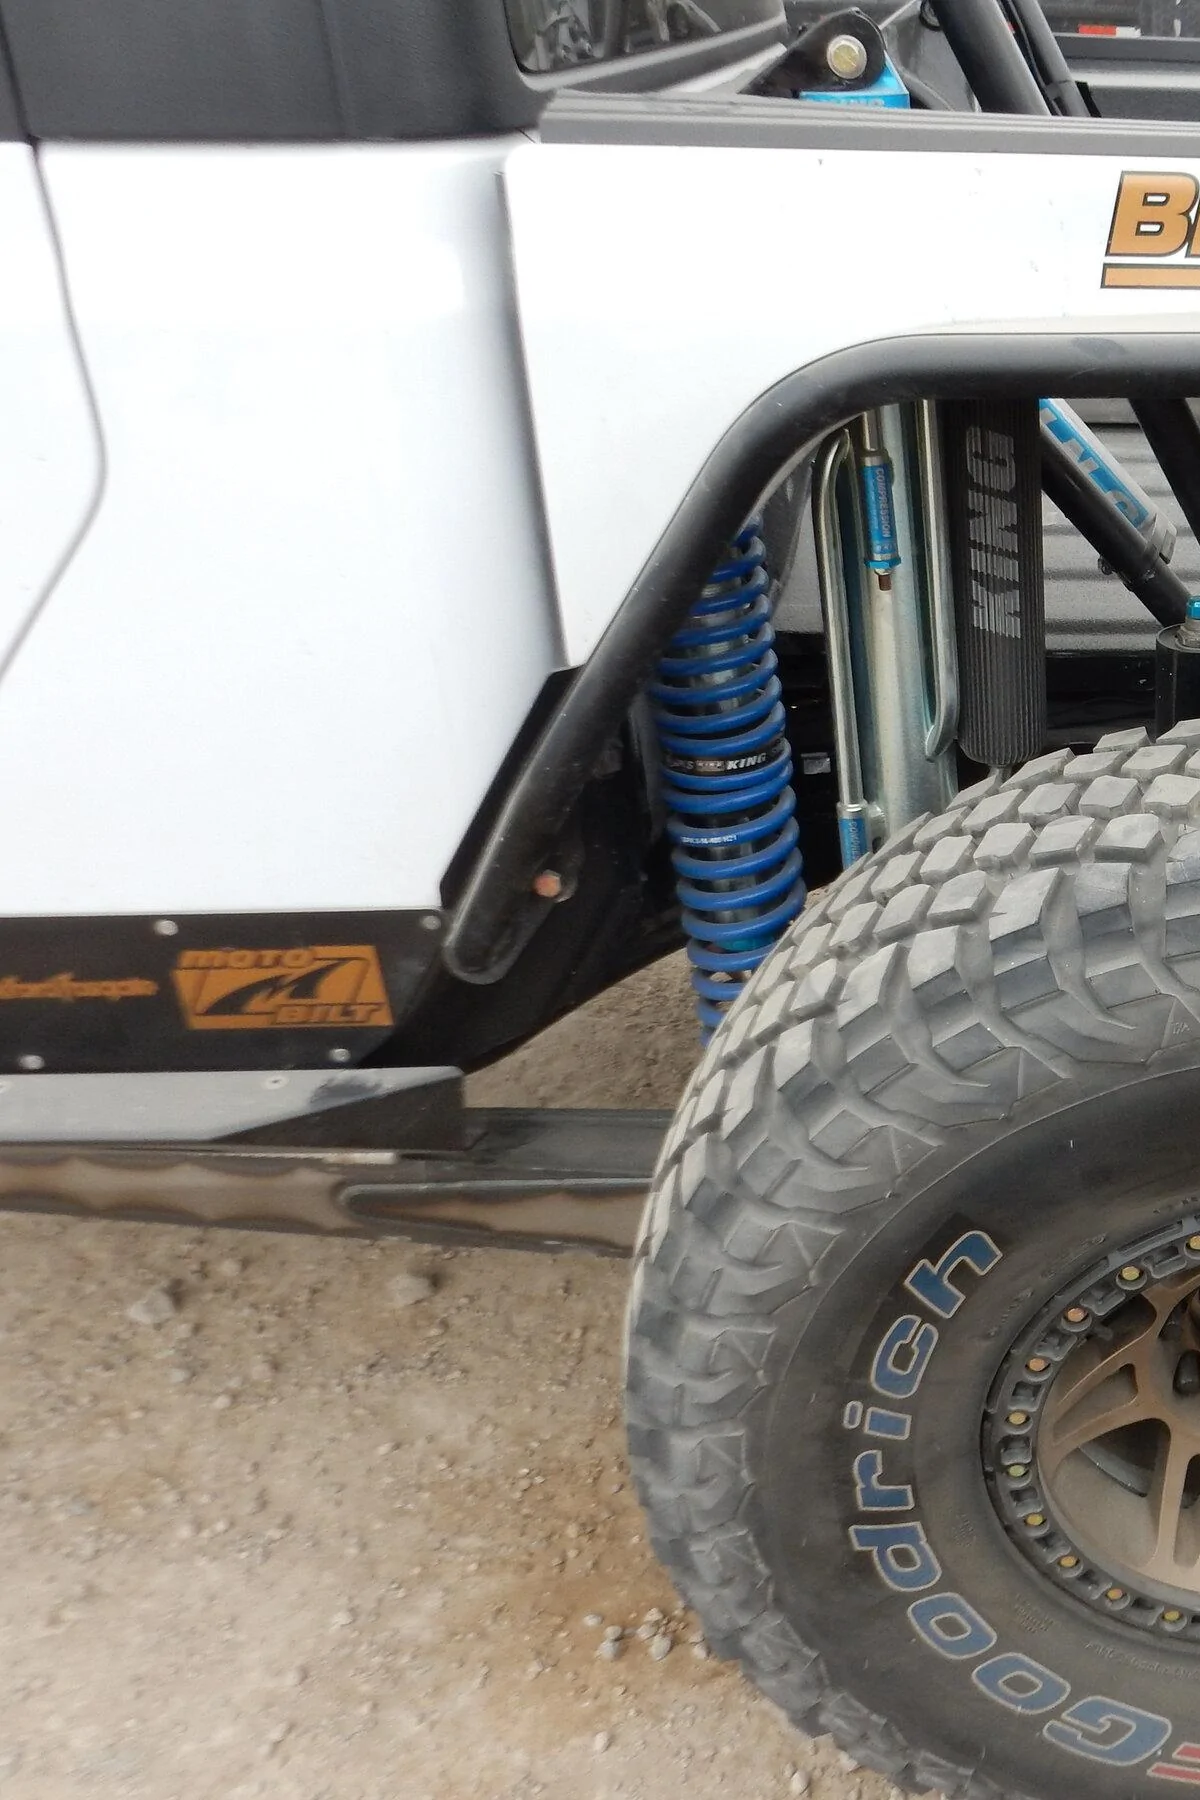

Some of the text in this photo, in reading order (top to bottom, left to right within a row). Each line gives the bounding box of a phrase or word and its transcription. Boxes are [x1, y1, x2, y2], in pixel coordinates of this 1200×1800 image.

[875, 467, 892, 538] COMPRESSION
[965, 425, 1022, 639] KING
[726, 752, 768, 771] KING
